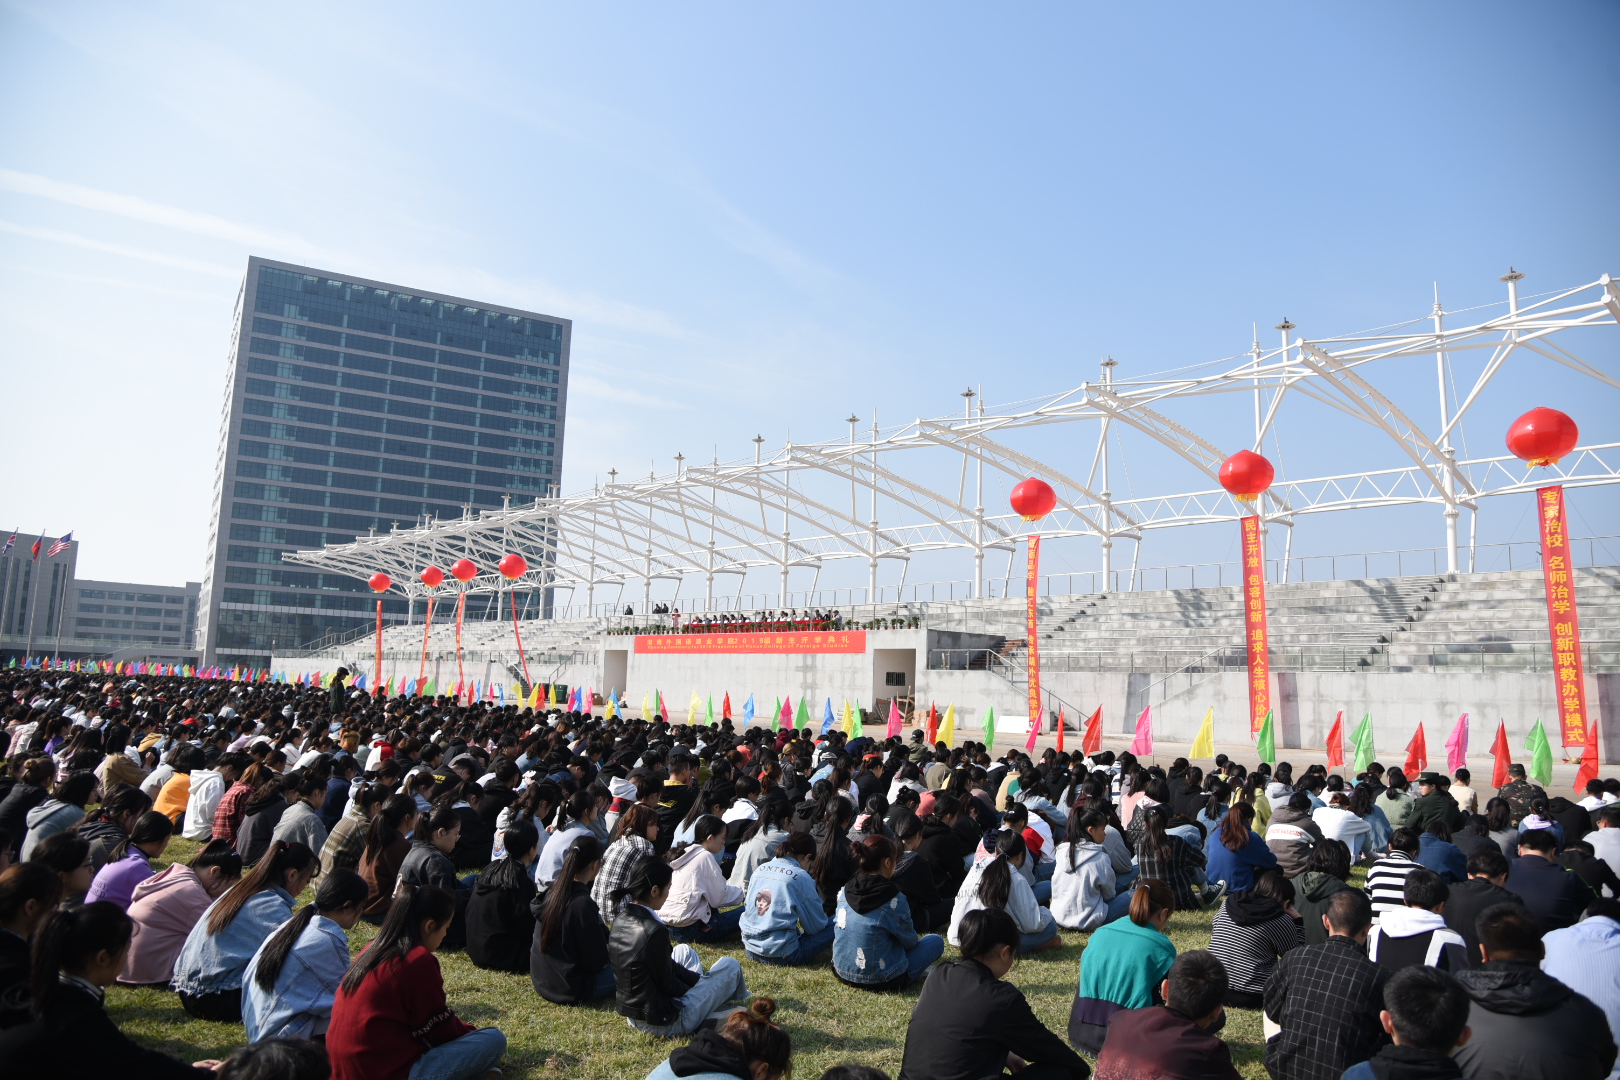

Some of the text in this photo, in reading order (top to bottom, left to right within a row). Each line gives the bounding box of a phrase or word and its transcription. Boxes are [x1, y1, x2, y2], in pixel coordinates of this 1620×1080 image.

[1245, 519, 1259, 568] 民主开放
[1248, 574, 1263, 622] 包容创新
[1542, 490, 1585, 743] 专家治校 名师治学 创新职教办学模式
